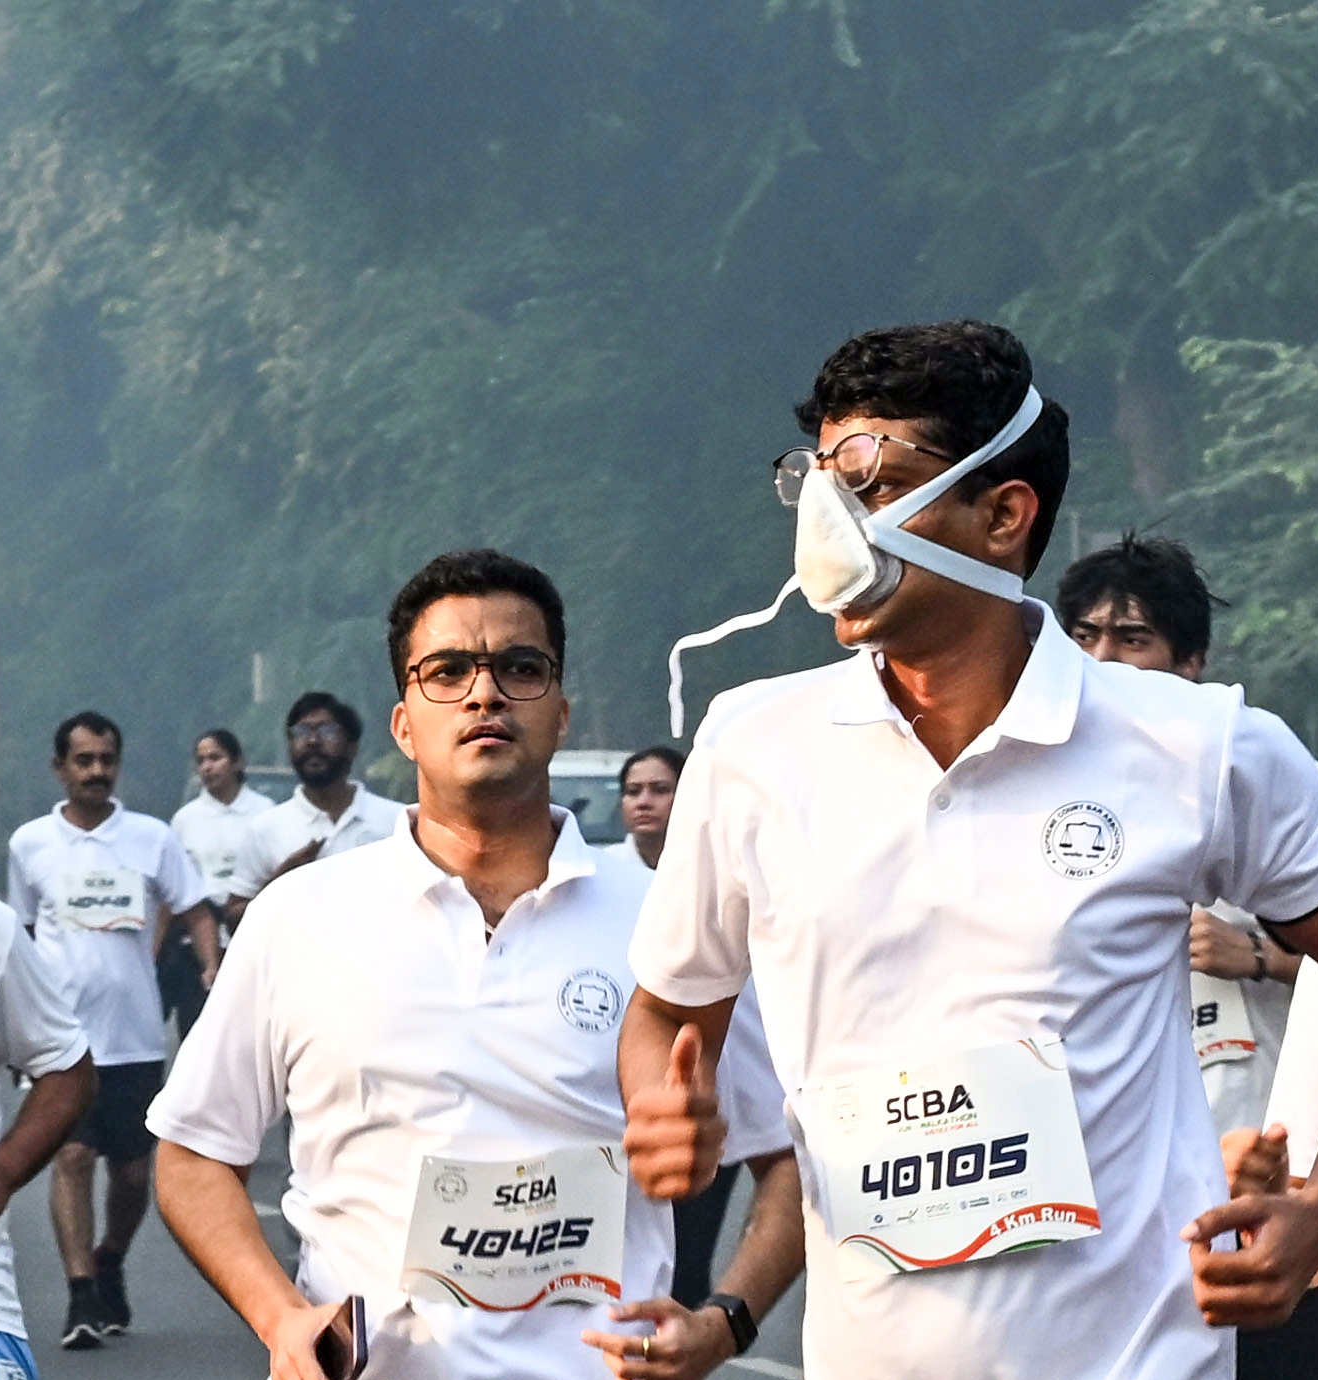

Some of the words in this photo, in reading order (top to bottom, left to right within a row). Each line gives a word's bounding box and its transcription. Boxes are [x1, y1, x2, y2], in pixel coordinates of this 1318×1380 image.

[887, 1084, 974, 1125] SCBA
[861, 1132, 1029, 1201] 40105
[493, 1175, 557, 1207] SCBA
[440, 1217, 594, 1259] 40425
[989, 1222, 1002, 1237] 4
[1003, 1212, 1035, 1230] Km
[1041, 1207, 1077, 1223] Run
